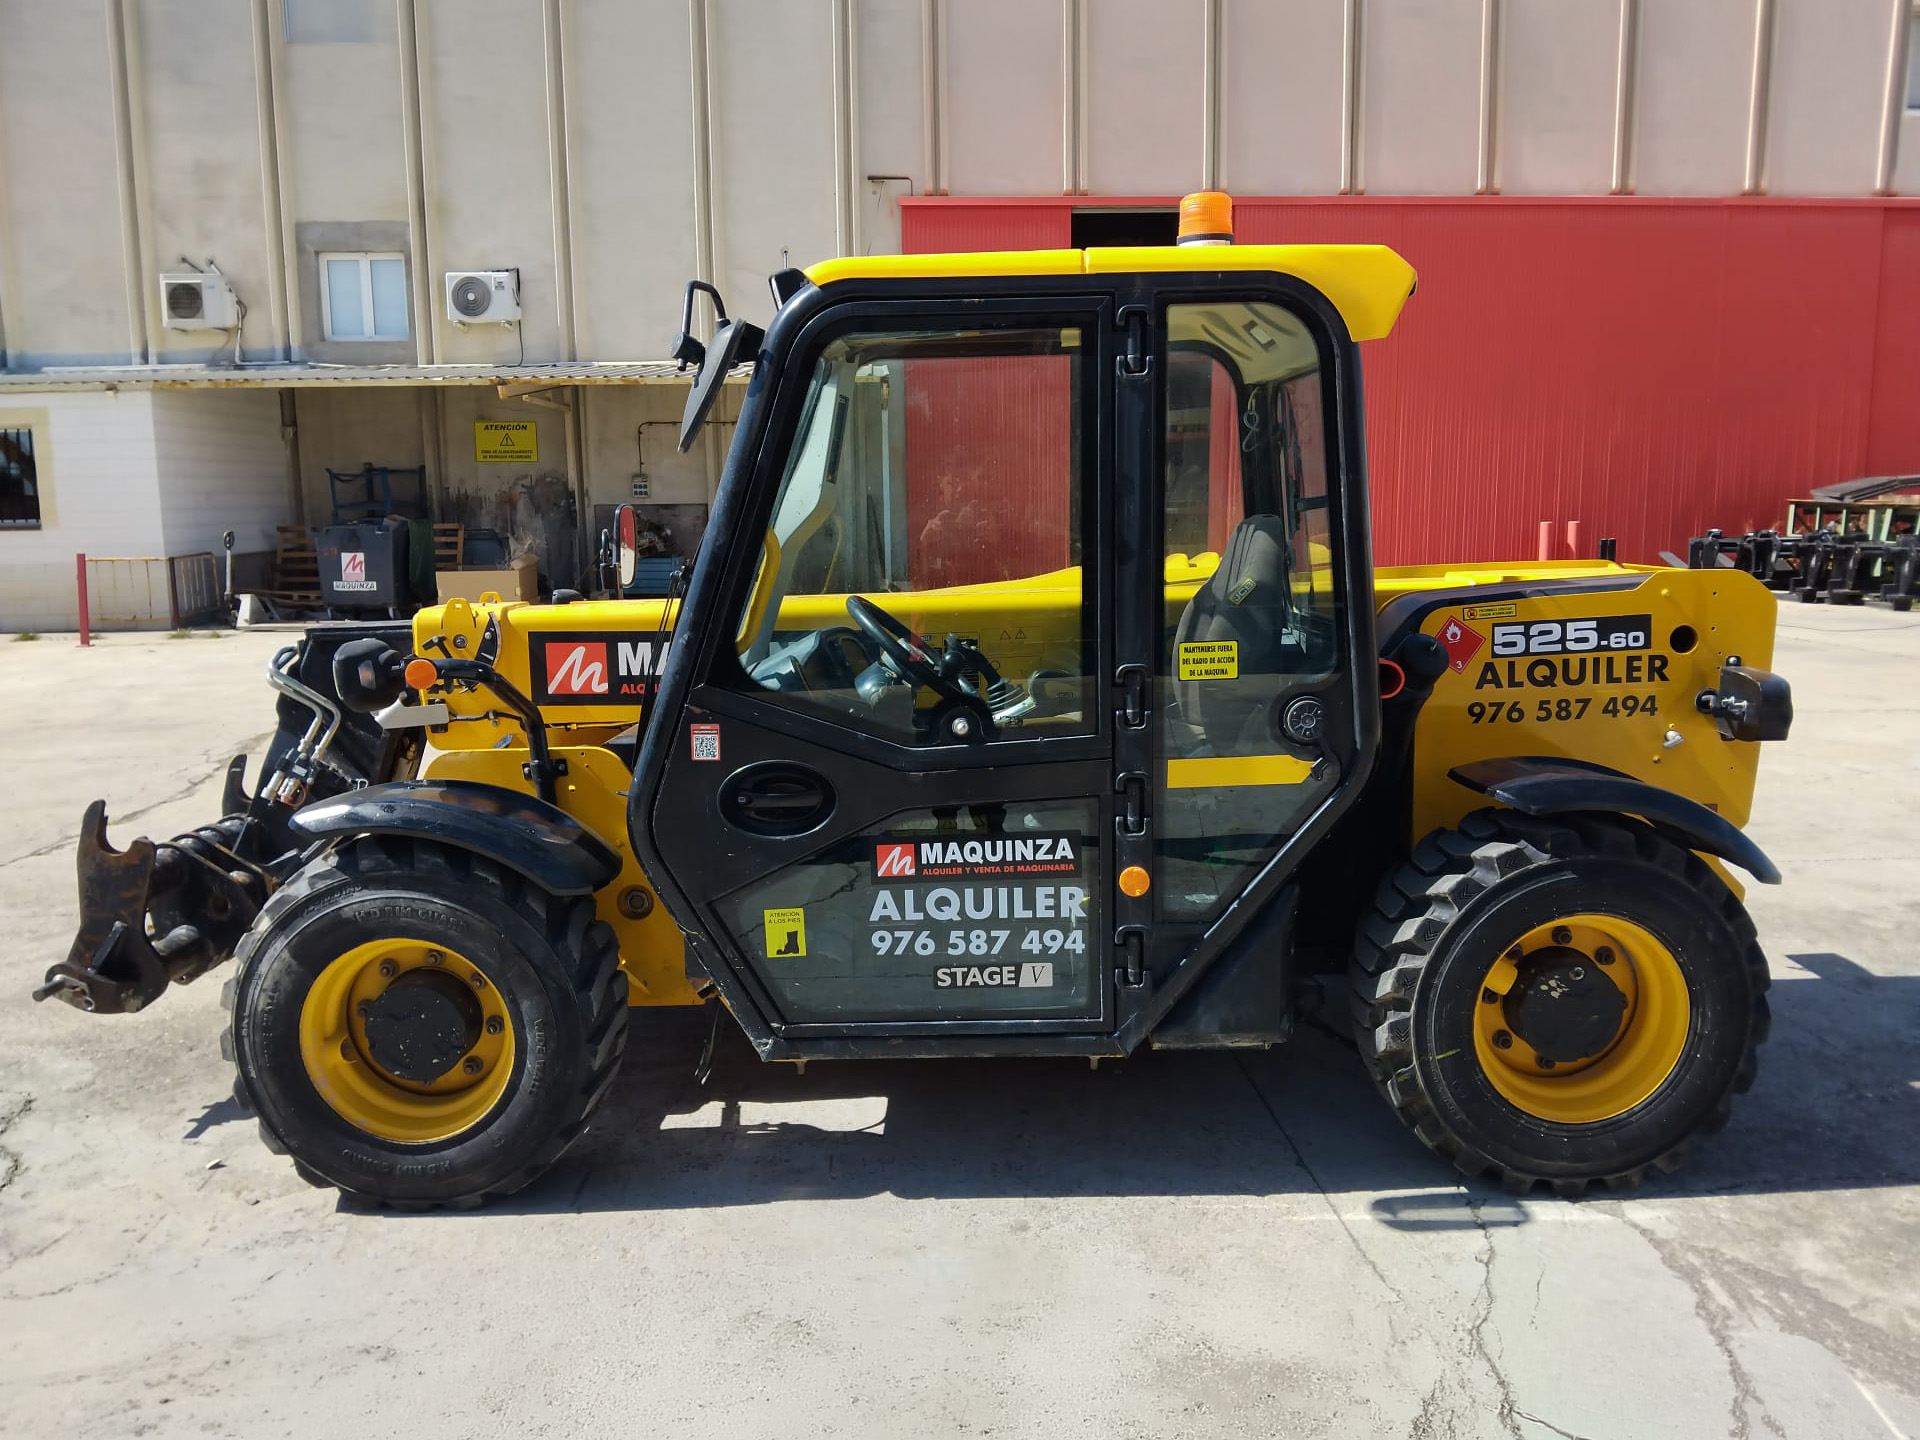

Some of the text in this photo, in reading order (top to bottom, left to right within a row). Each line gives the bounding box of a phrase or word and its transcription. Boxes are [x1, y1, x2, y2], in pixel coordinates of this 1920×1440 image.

[335, 581, 375, 590] MAQUINZA
[1184, 644, 1233, 653] MANTENERSE FUERA
[1182, 657, 1191, 665] DEL
[1192, 656, 1208, 665] RADIO
[1209, 656, 1216, 664] DE
[1456, 660, 1463, 669] 3
[1189, 669, 1196, 677] DE
[1197, 668, 1203, 676] LA
[1475, 654, 1670, 690] ALQUILER
[1467, 695, 1658, 724] 976 587 494
[920, 838, 1075, 864] MAQUINZA
[922, 863, 1075, 876] ALQUILER Y VENTA DE MAQUINARIA
[869, 886, 1088, 922] ALQUILER
[871, 929, 1086, 956] 976 587 494
[936, 965, 1045, 987] STAGE V
